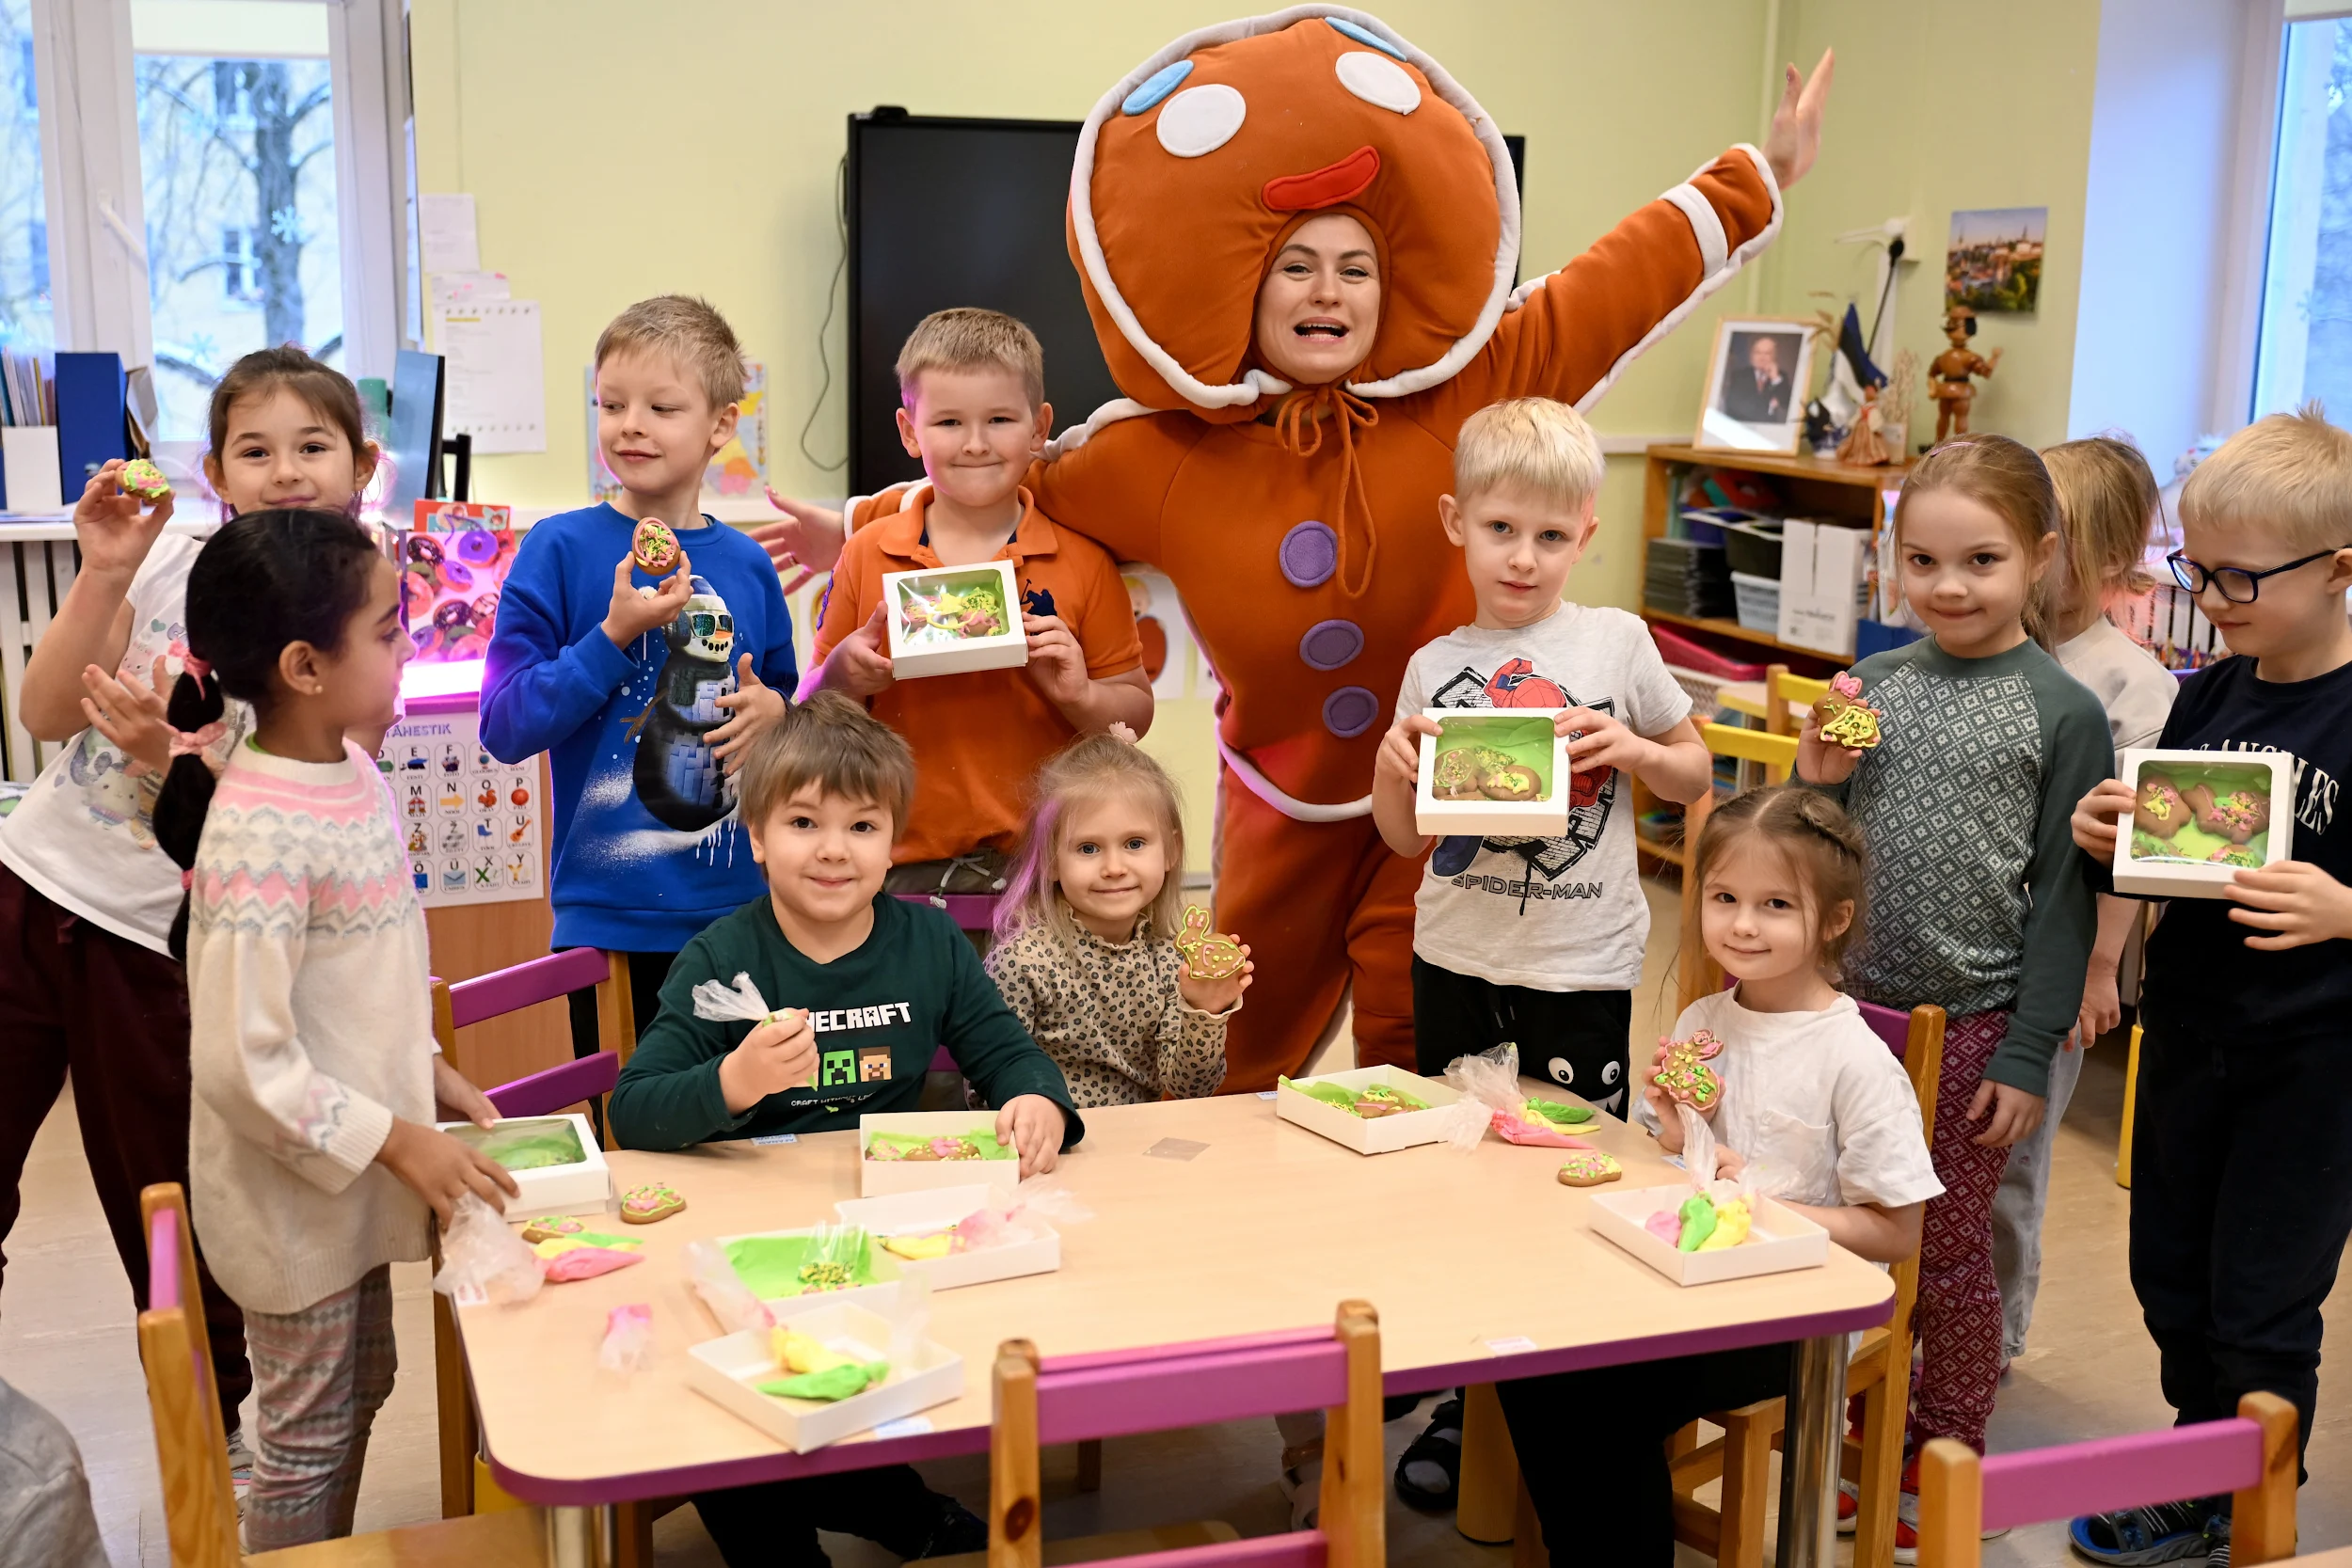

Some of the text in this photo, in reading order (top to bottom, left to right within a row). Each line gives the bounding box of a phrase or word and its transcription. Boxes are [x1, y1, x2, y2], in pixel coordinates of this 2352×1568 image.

[411, 747, 418, 757] E
[447, 745, 453, 754] F
[447, 782, 456, 793] N
[482, 780, 491, 790] O
[516, 778, 523, 787] P
[410, 785, 421, 796] M
[485, 818, 491, 828] T
[516, 816, 524, 825] U
[414, 823, 421, 832] Z
[485, 856, 493, 865] X
[516, 854, 524, 863] Y
[414, 861, 423, 873] Ö
[450, 858, 459, 870] Ü
[1451, 873, 1603, 900] SPIDER-MAN
[806, 1002, 912, 1033] ECRAFT
